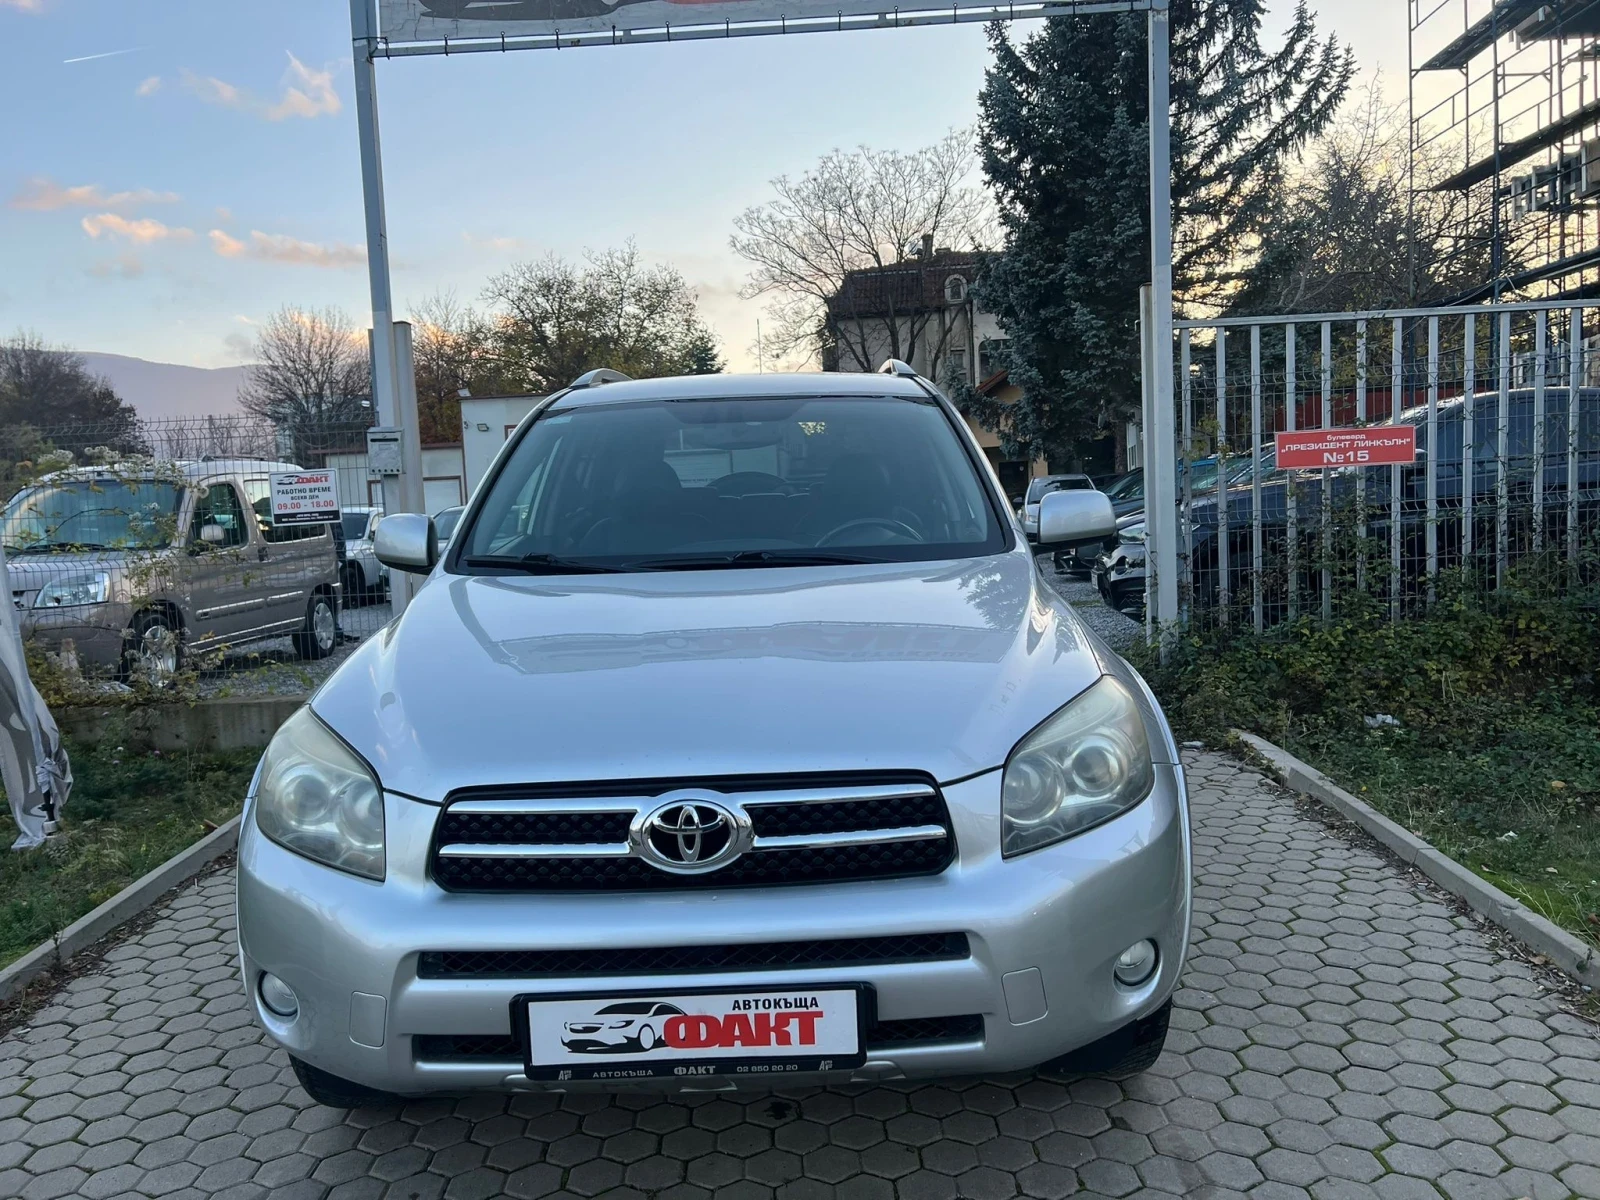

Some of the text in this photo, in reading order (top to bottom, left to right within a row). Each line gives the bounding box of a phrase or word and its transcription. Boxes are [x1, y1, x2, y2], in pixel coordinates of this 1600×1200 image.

[277, 502, 301, 510] 09.00
[311, 500, 334, 508] 18.00
[732, 997, 819, 1012] АВТОКЪЩА
[663, 1011, 824, 1048] ФАКТ
[674, 1066, 716, 1075] ФАКТ
